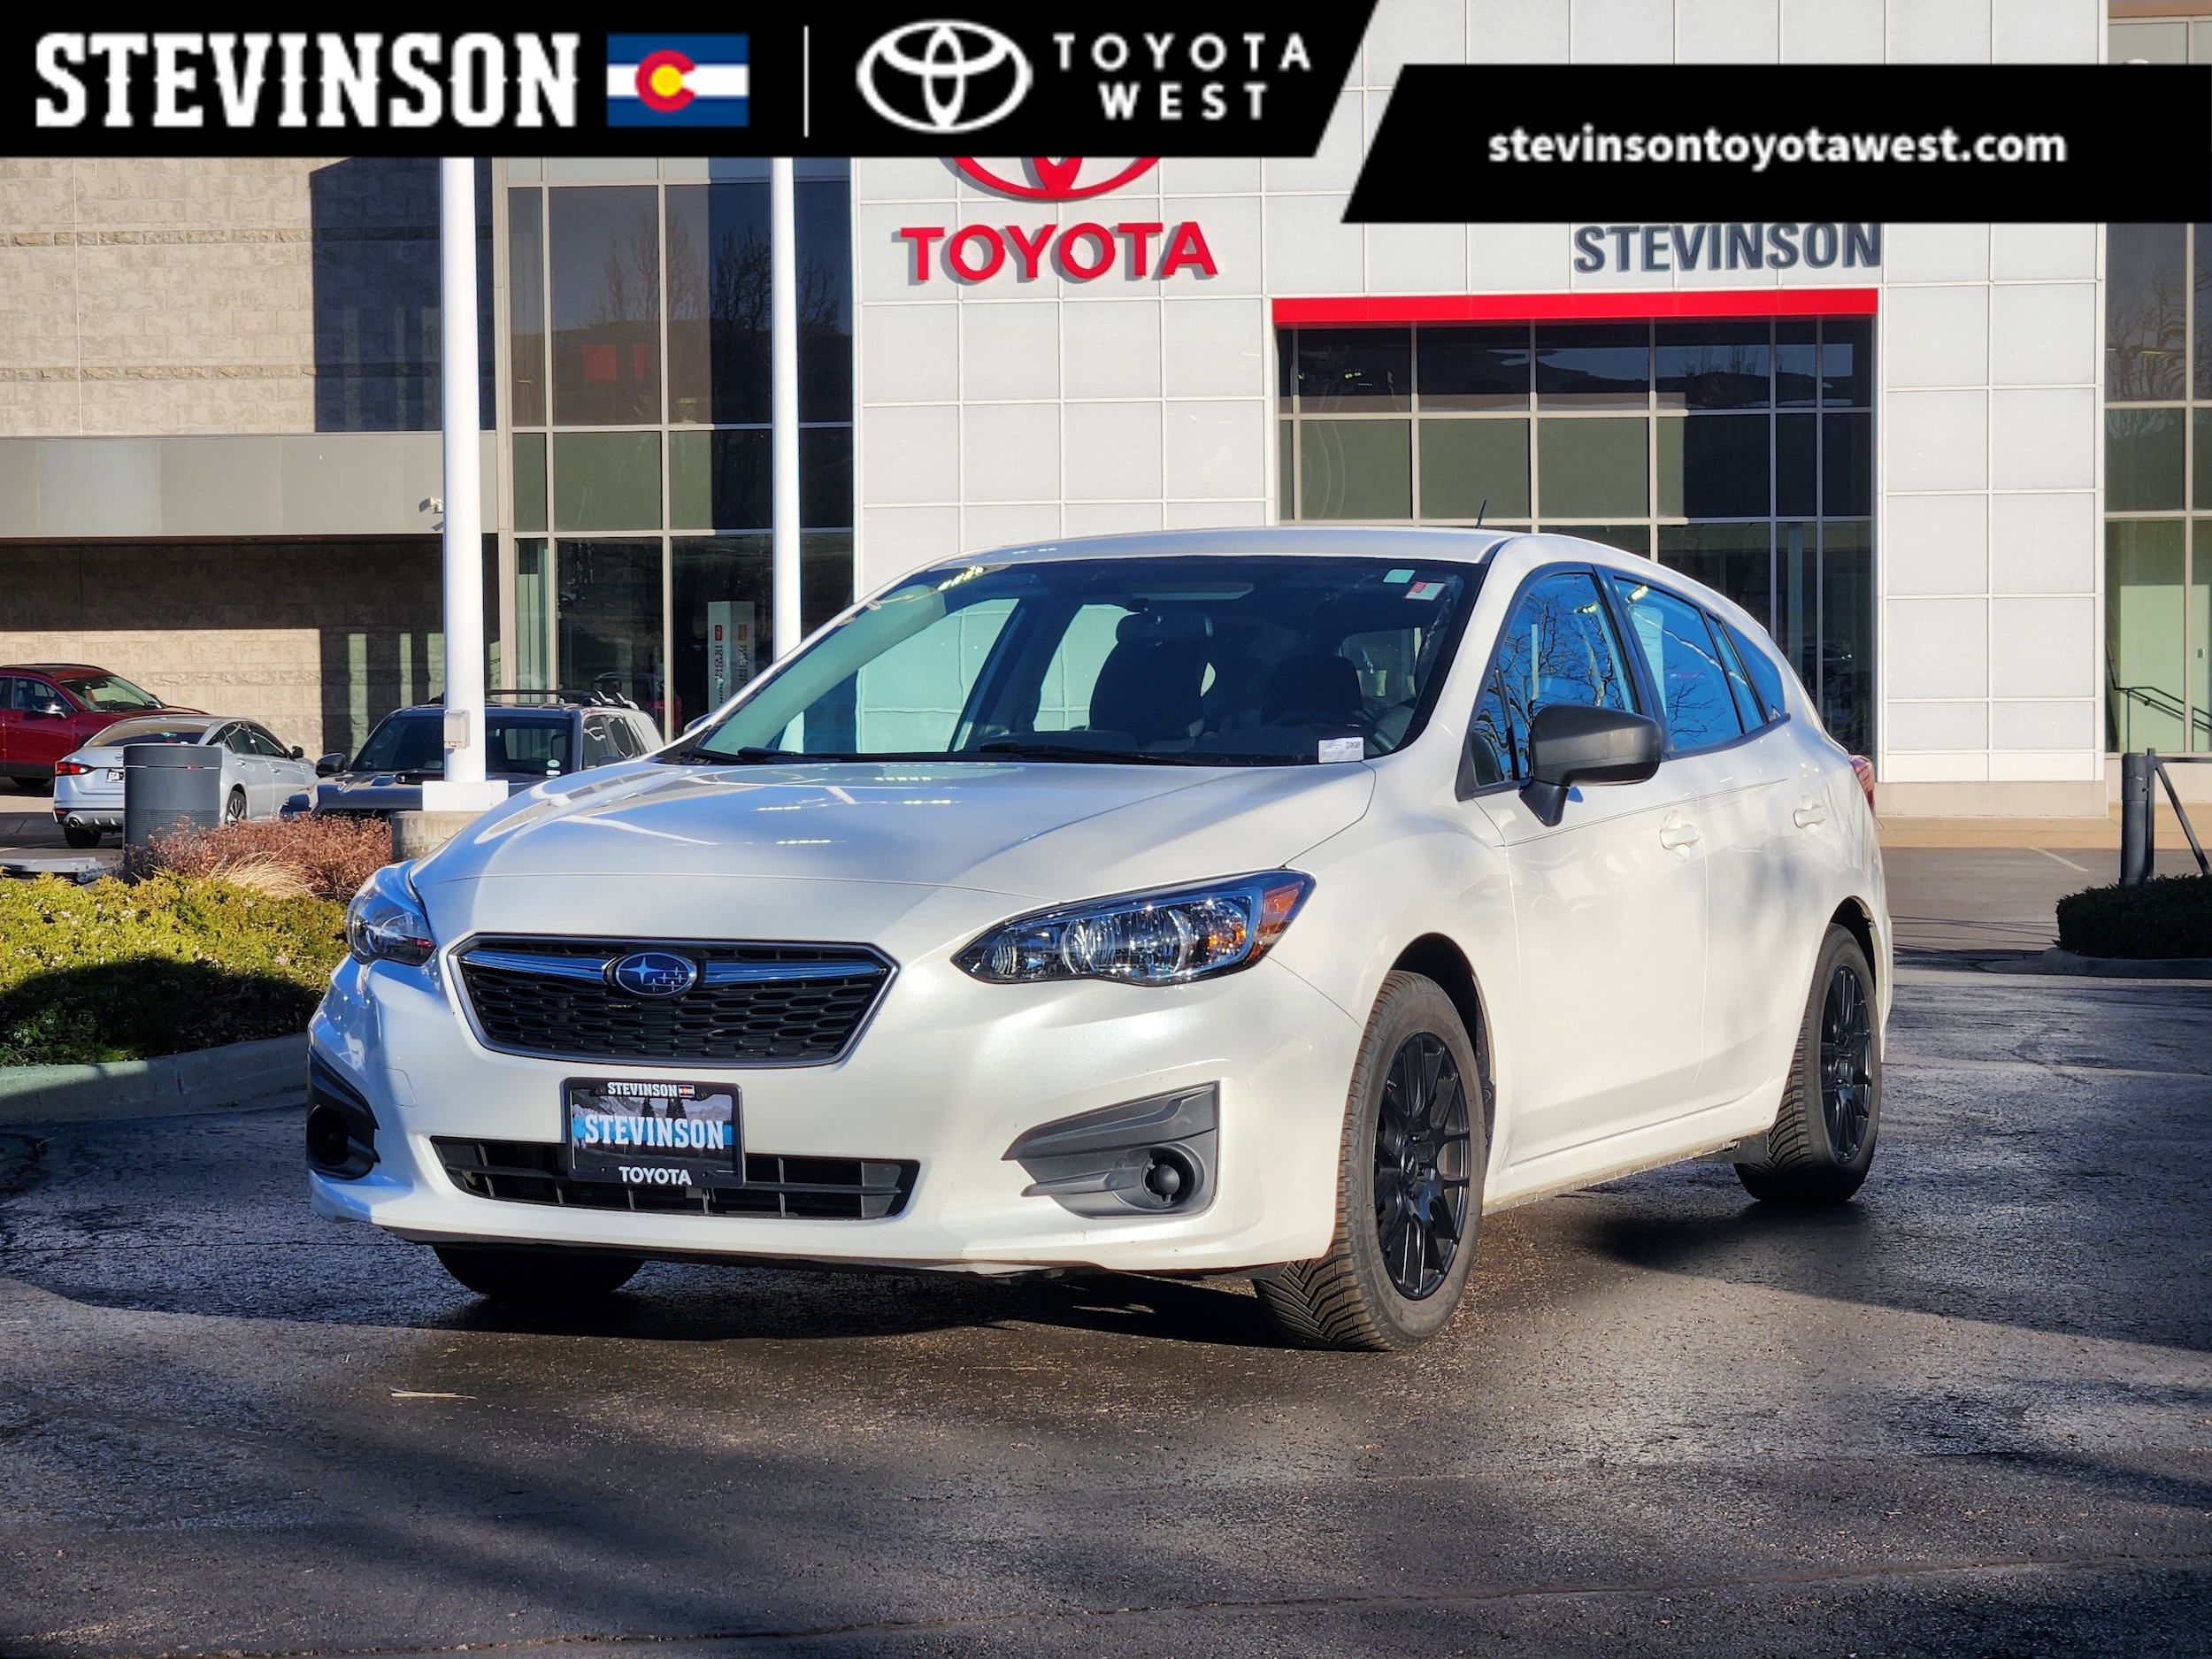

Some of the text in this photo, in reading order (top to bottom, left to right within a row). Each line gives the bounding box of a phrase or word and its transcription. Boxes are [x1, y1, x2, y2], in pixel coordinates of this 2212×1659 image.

[899, 221, 1219, 281] TOYOTA
[1574, 223, 1882, 273] STEVINSON
[607, 1081, 679, 1097] STEVINSON
[585, 1114, 725, 1150] STEVINSON
[618, 1166, 692, 1187] TOYOTA
